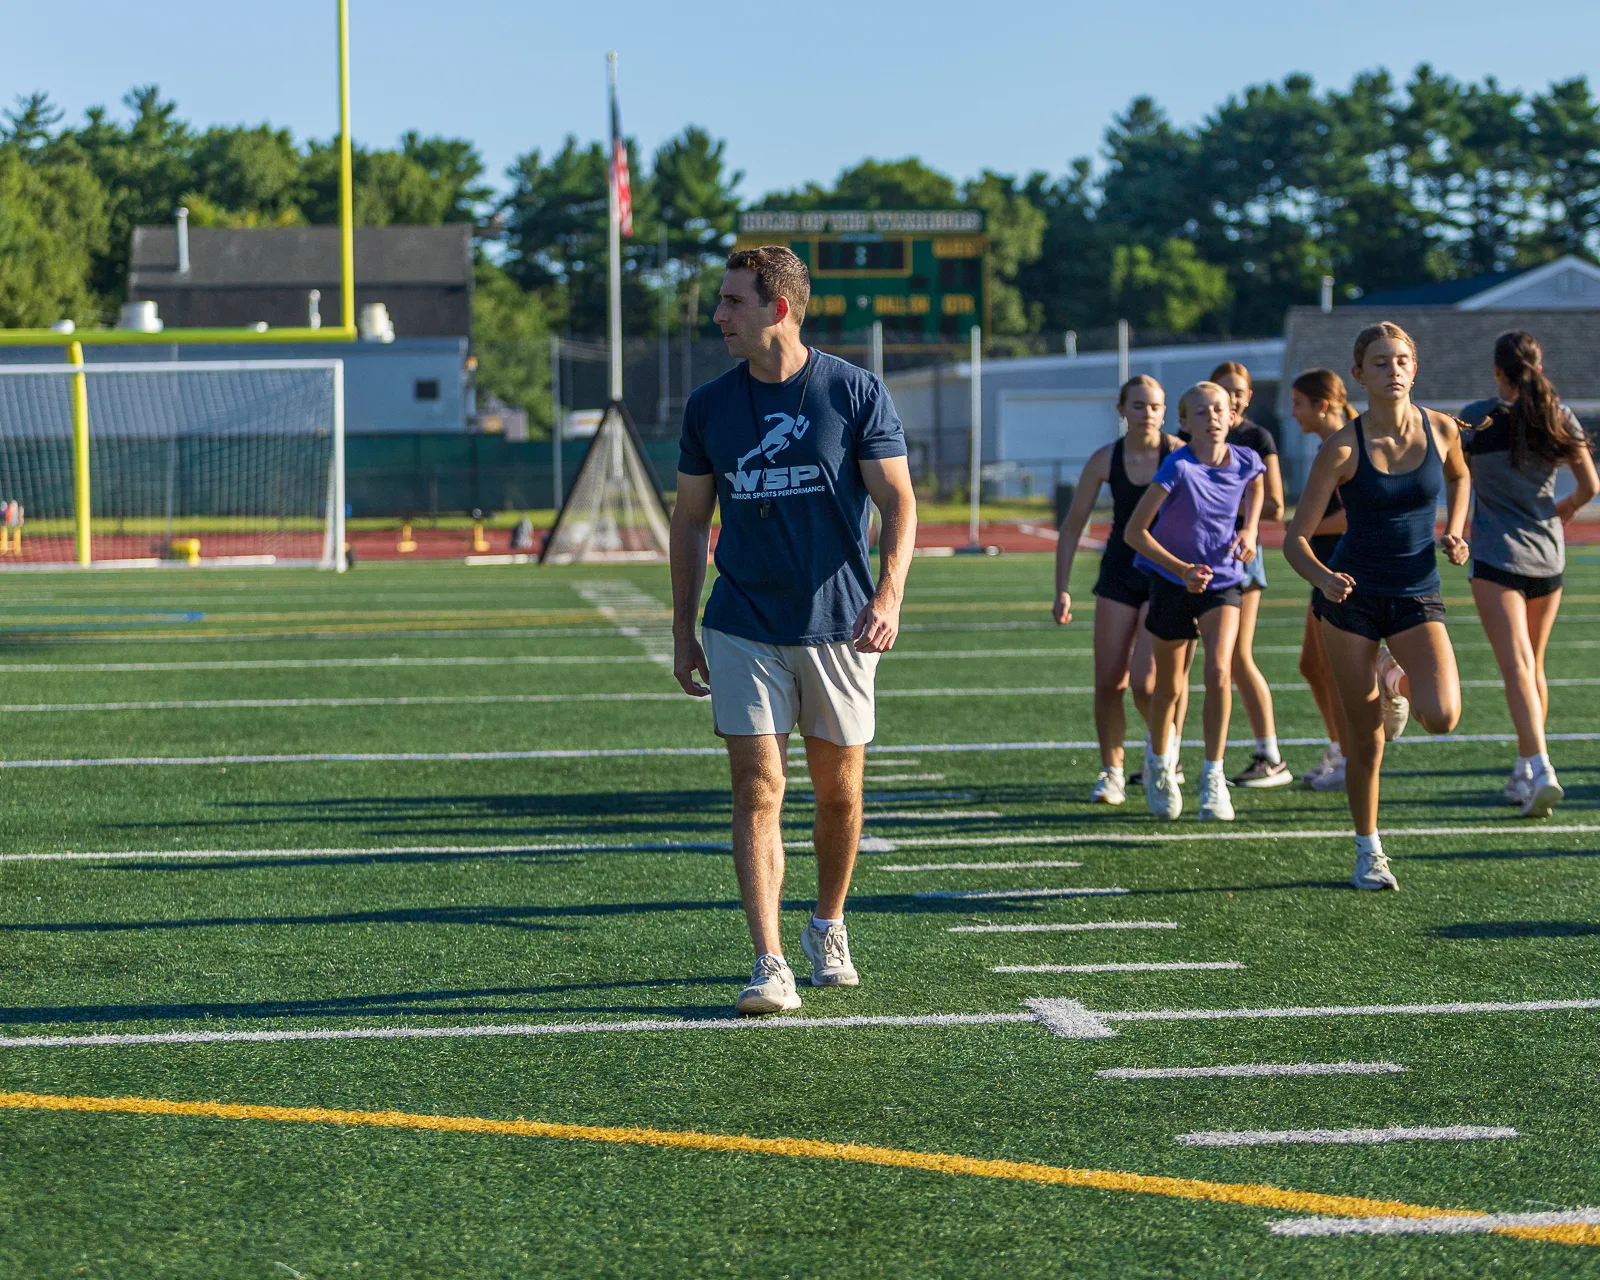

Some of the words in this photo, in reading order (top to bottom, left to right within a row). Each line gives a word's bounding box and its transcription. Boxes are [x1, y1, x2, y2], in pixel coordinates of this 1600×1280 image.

[724, 465, 820, 492] WSP
[731, 492, 752, 500] WARRIOR
[752, 490, 777, 499] SPORTS
[777, 485, 826, 497] PERFORMANCE
